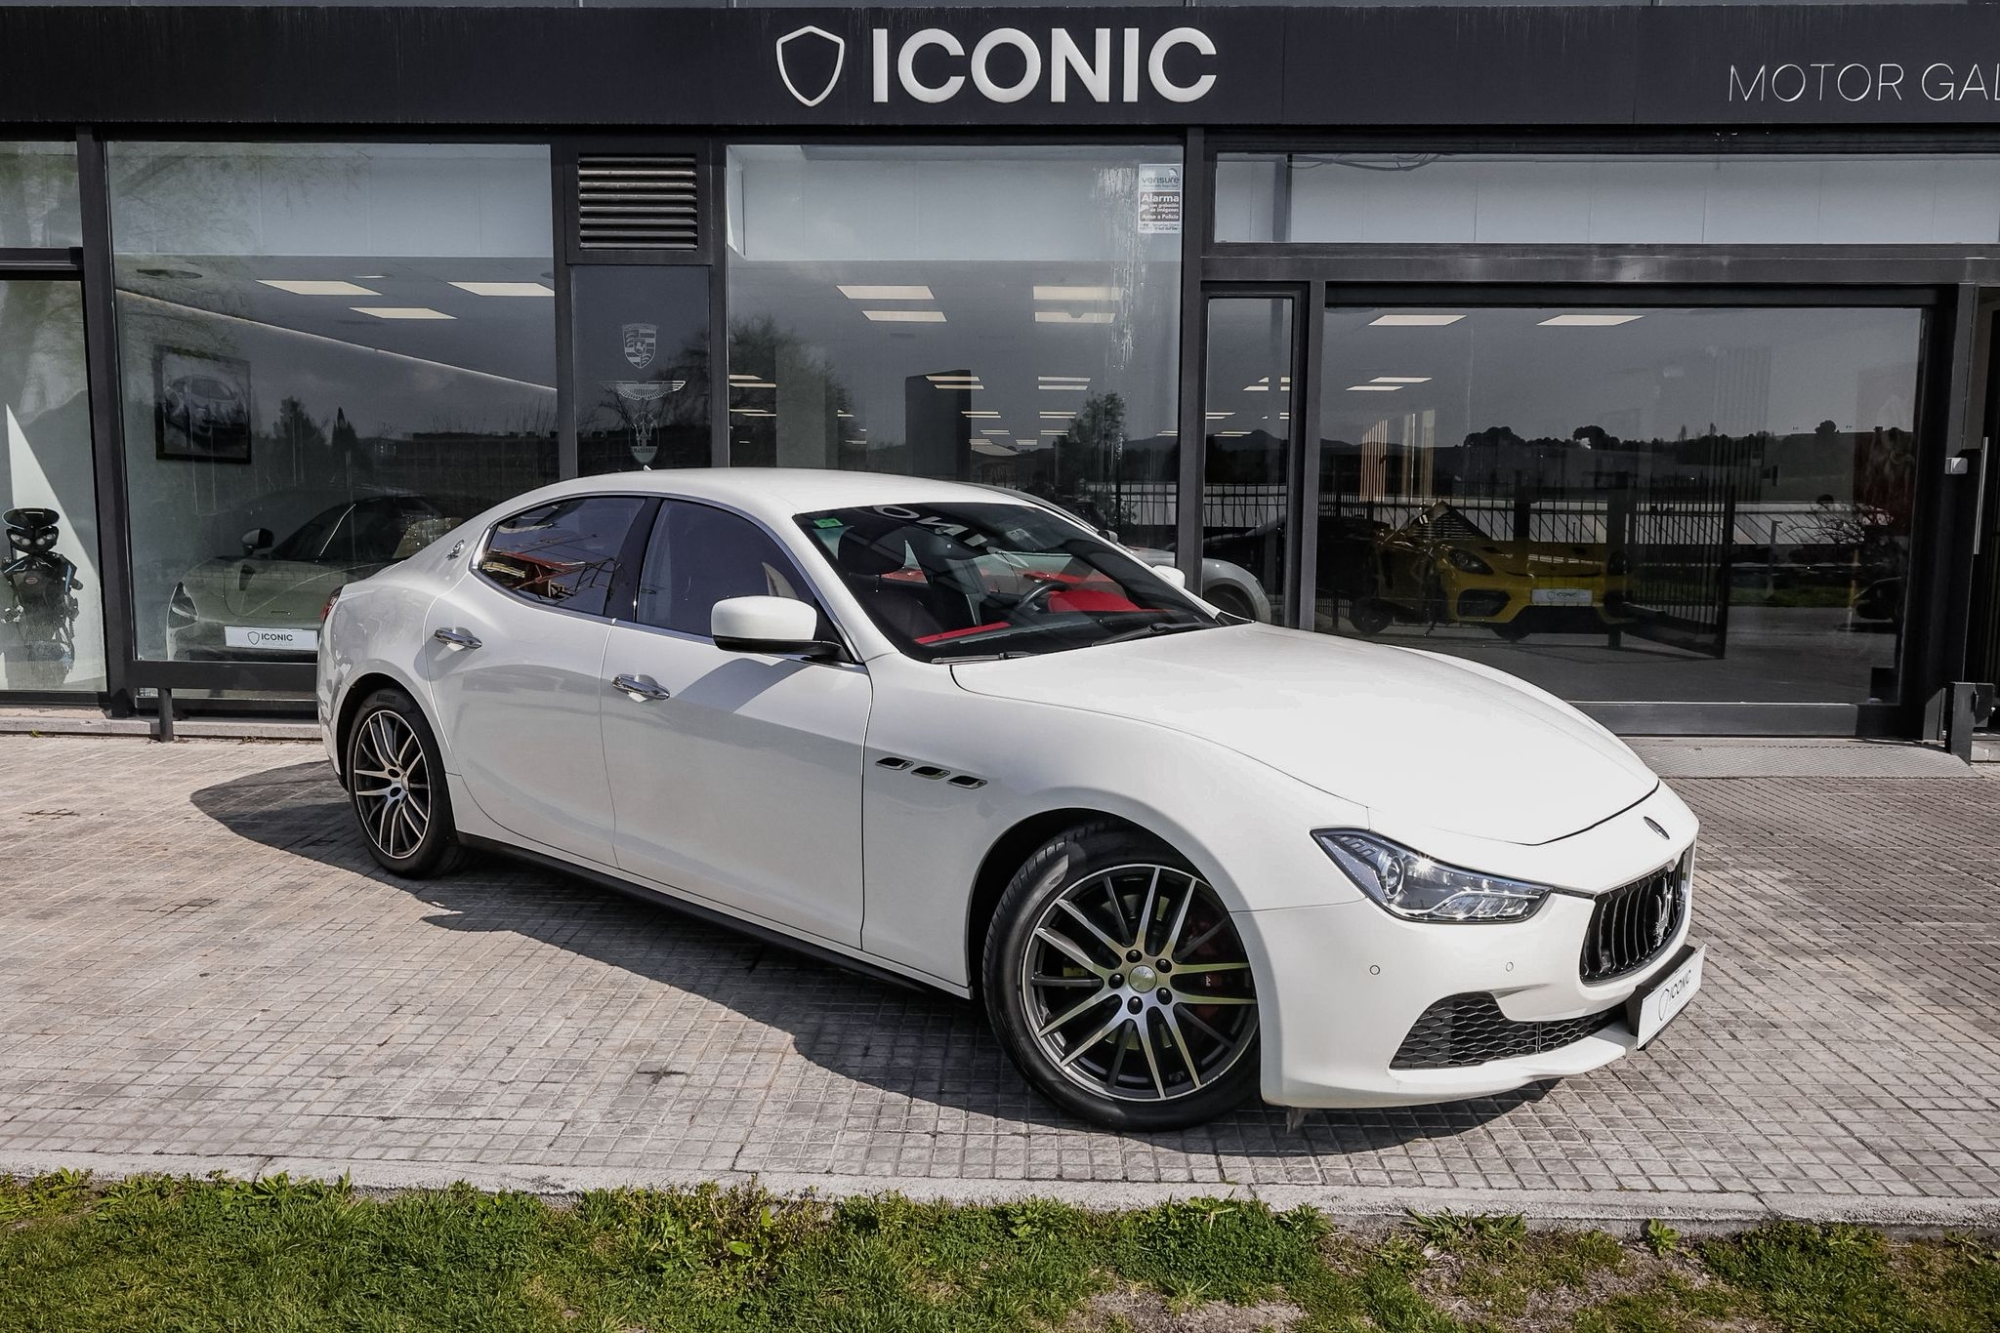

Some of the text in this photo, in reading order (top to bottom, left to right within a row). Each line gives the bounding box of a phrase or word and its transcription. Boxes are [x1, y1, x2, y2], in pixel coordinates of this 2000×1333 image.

[873, 27, 1217, 103] ICONIC
[1728, 63, 1902, 102] MOTOR
[1141, 176, 1180, 184] verisure
[1141, 193, 1180, 202] Alarma
[261, 633, 293, 642] ICONIC
